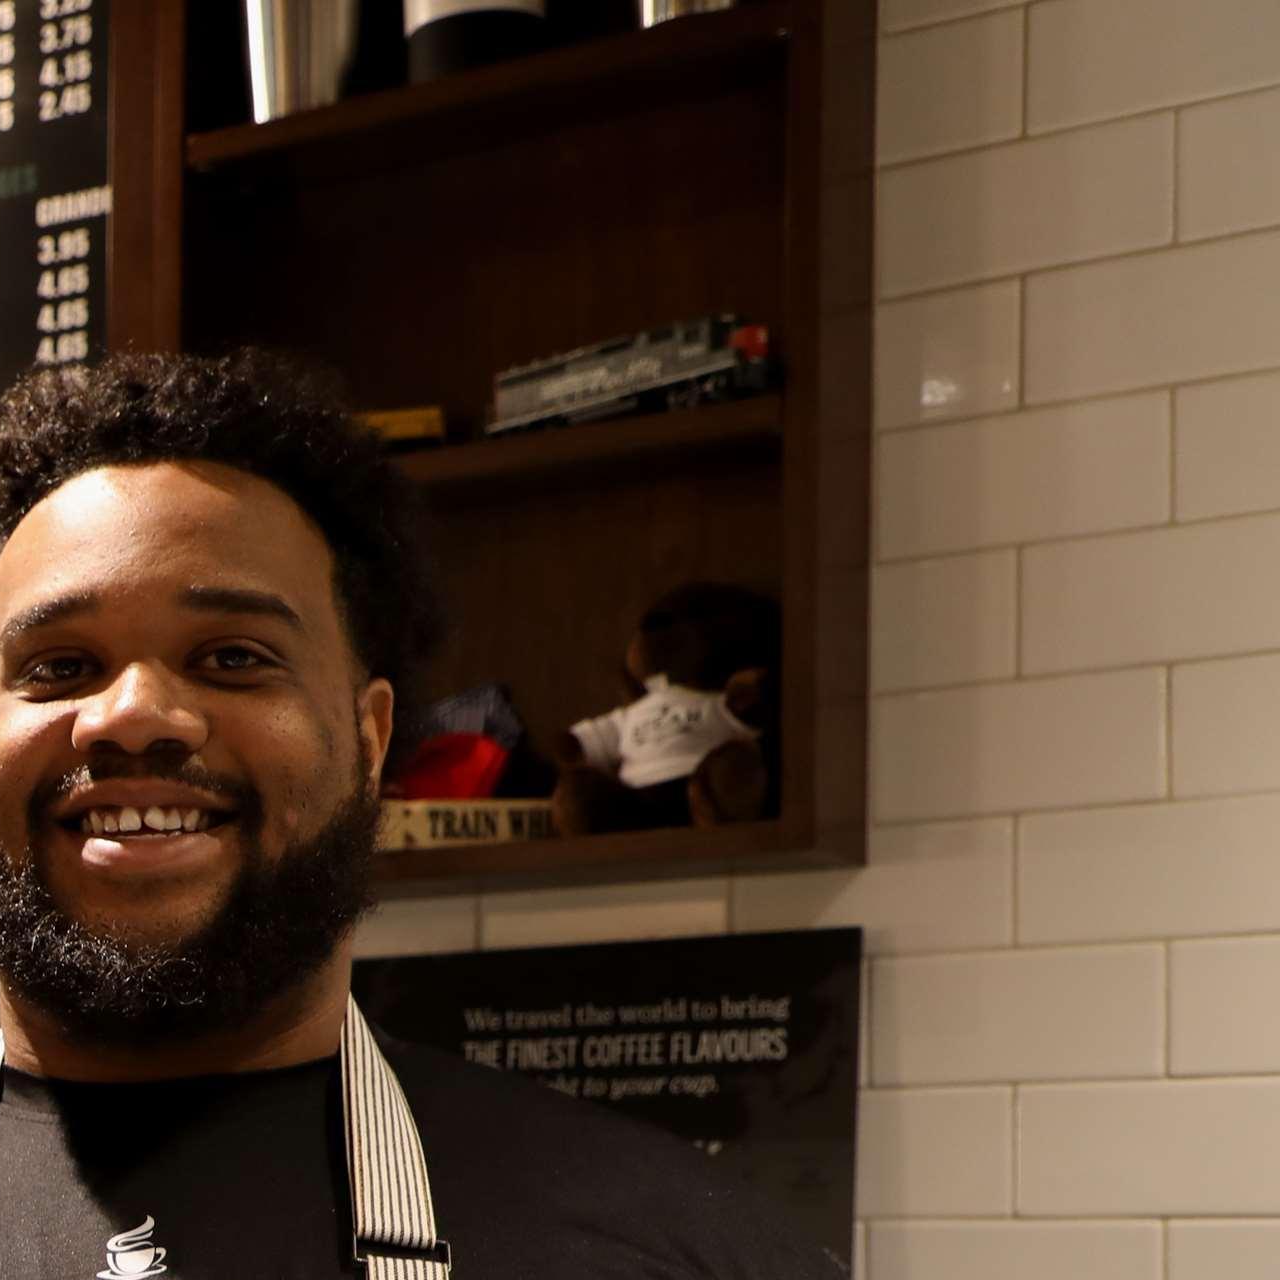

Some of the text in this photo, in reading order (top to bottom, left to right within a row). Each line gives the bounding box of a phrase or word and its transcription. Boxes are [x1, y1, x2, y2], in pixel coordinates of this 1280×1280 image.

[40, 14, 92, 54] 3.75
[40, 50, 92, 87] 4.15
[40, 83, 92, 122] 2.45
[427, 807, 499, 840] TRAIN
[465, 994, 790, 1031] We travel the world to bring
[464, 1026, 789, 1071] THE FINEST COFFEE FLAVOURS
[584, 1076, 609, 1096] to
[610, 1075, 667, 1101] your
[669, 1073, 720, 1098] cup.
